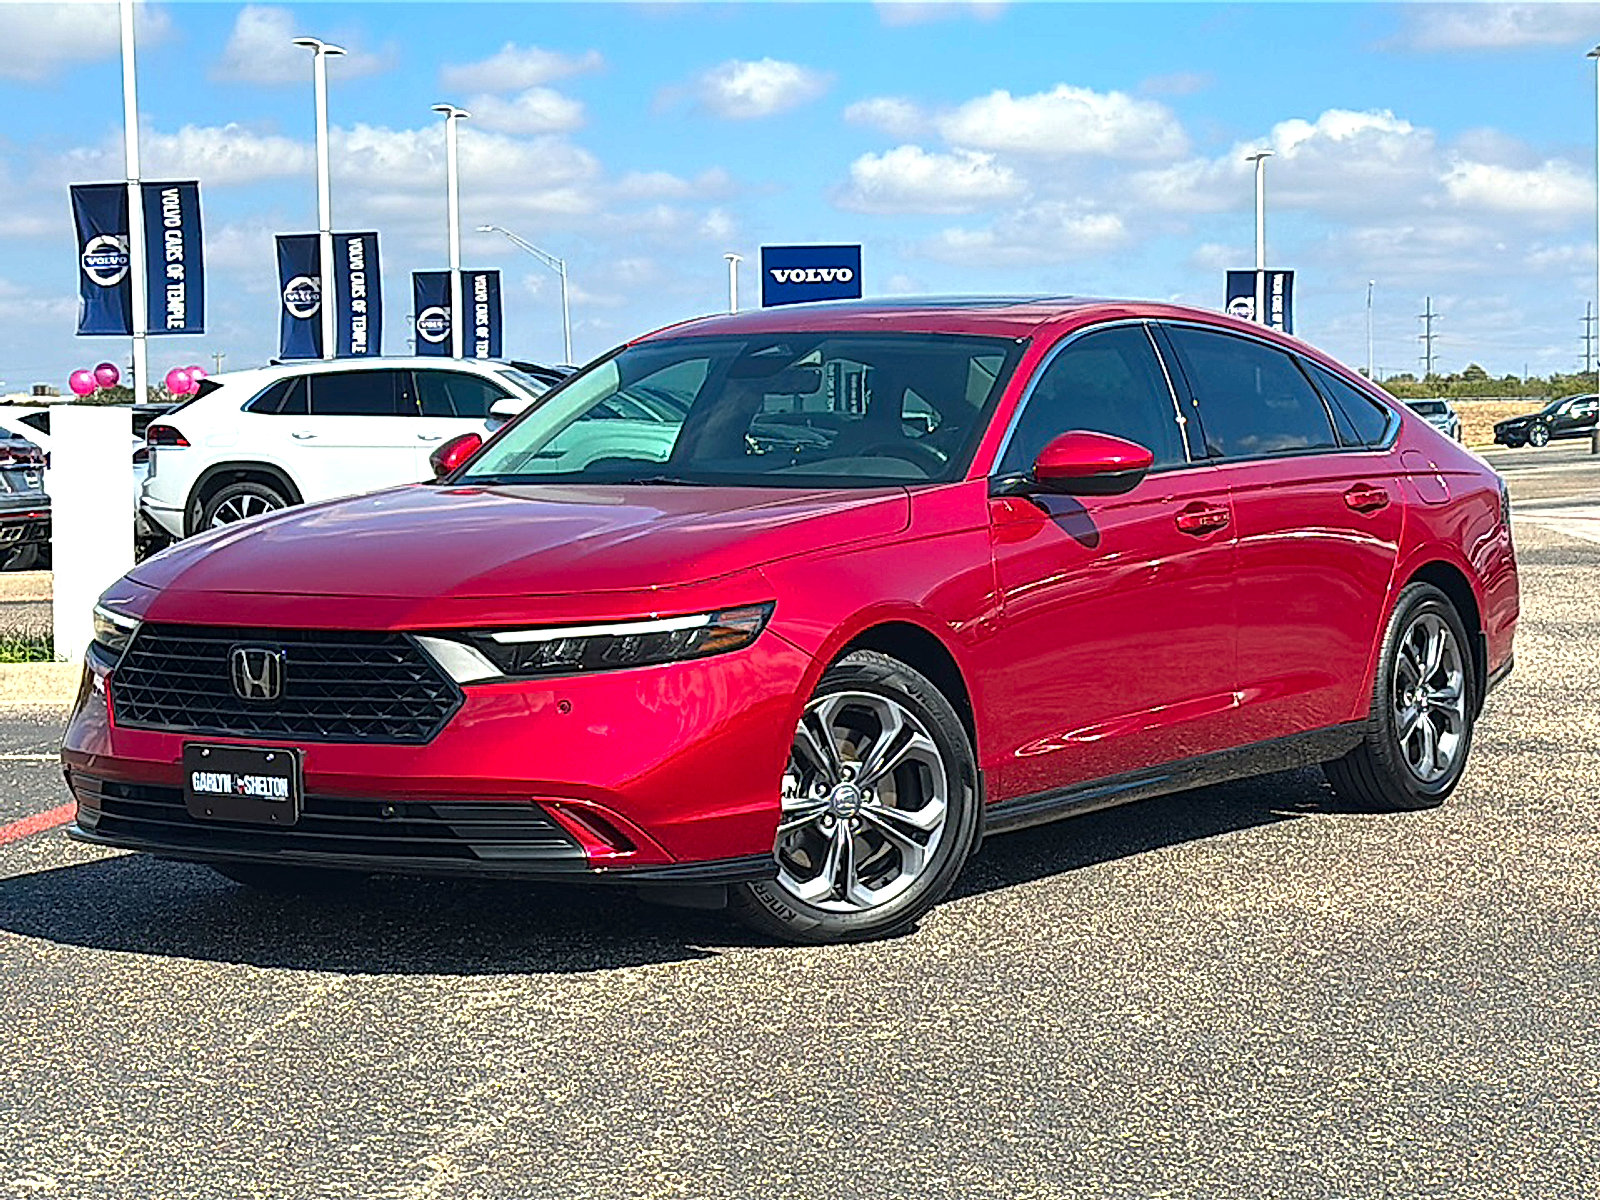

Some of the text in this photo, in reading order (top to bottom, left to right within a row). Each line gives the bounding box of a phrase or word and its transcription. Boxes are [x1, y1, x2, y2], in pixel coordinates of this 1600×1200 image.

[85, 256, 128, 265] VOLVO
[162, 188, 185, 330] VOLVO CARS OF TEMPLE
[769, 268, 853, 283] VOLVO
[348, 237, 367, 354] VOLVO CARS OF TEMPLE
[243, 775, 289, 798] SHELTON
[753, 883, 798, 922] KINER
